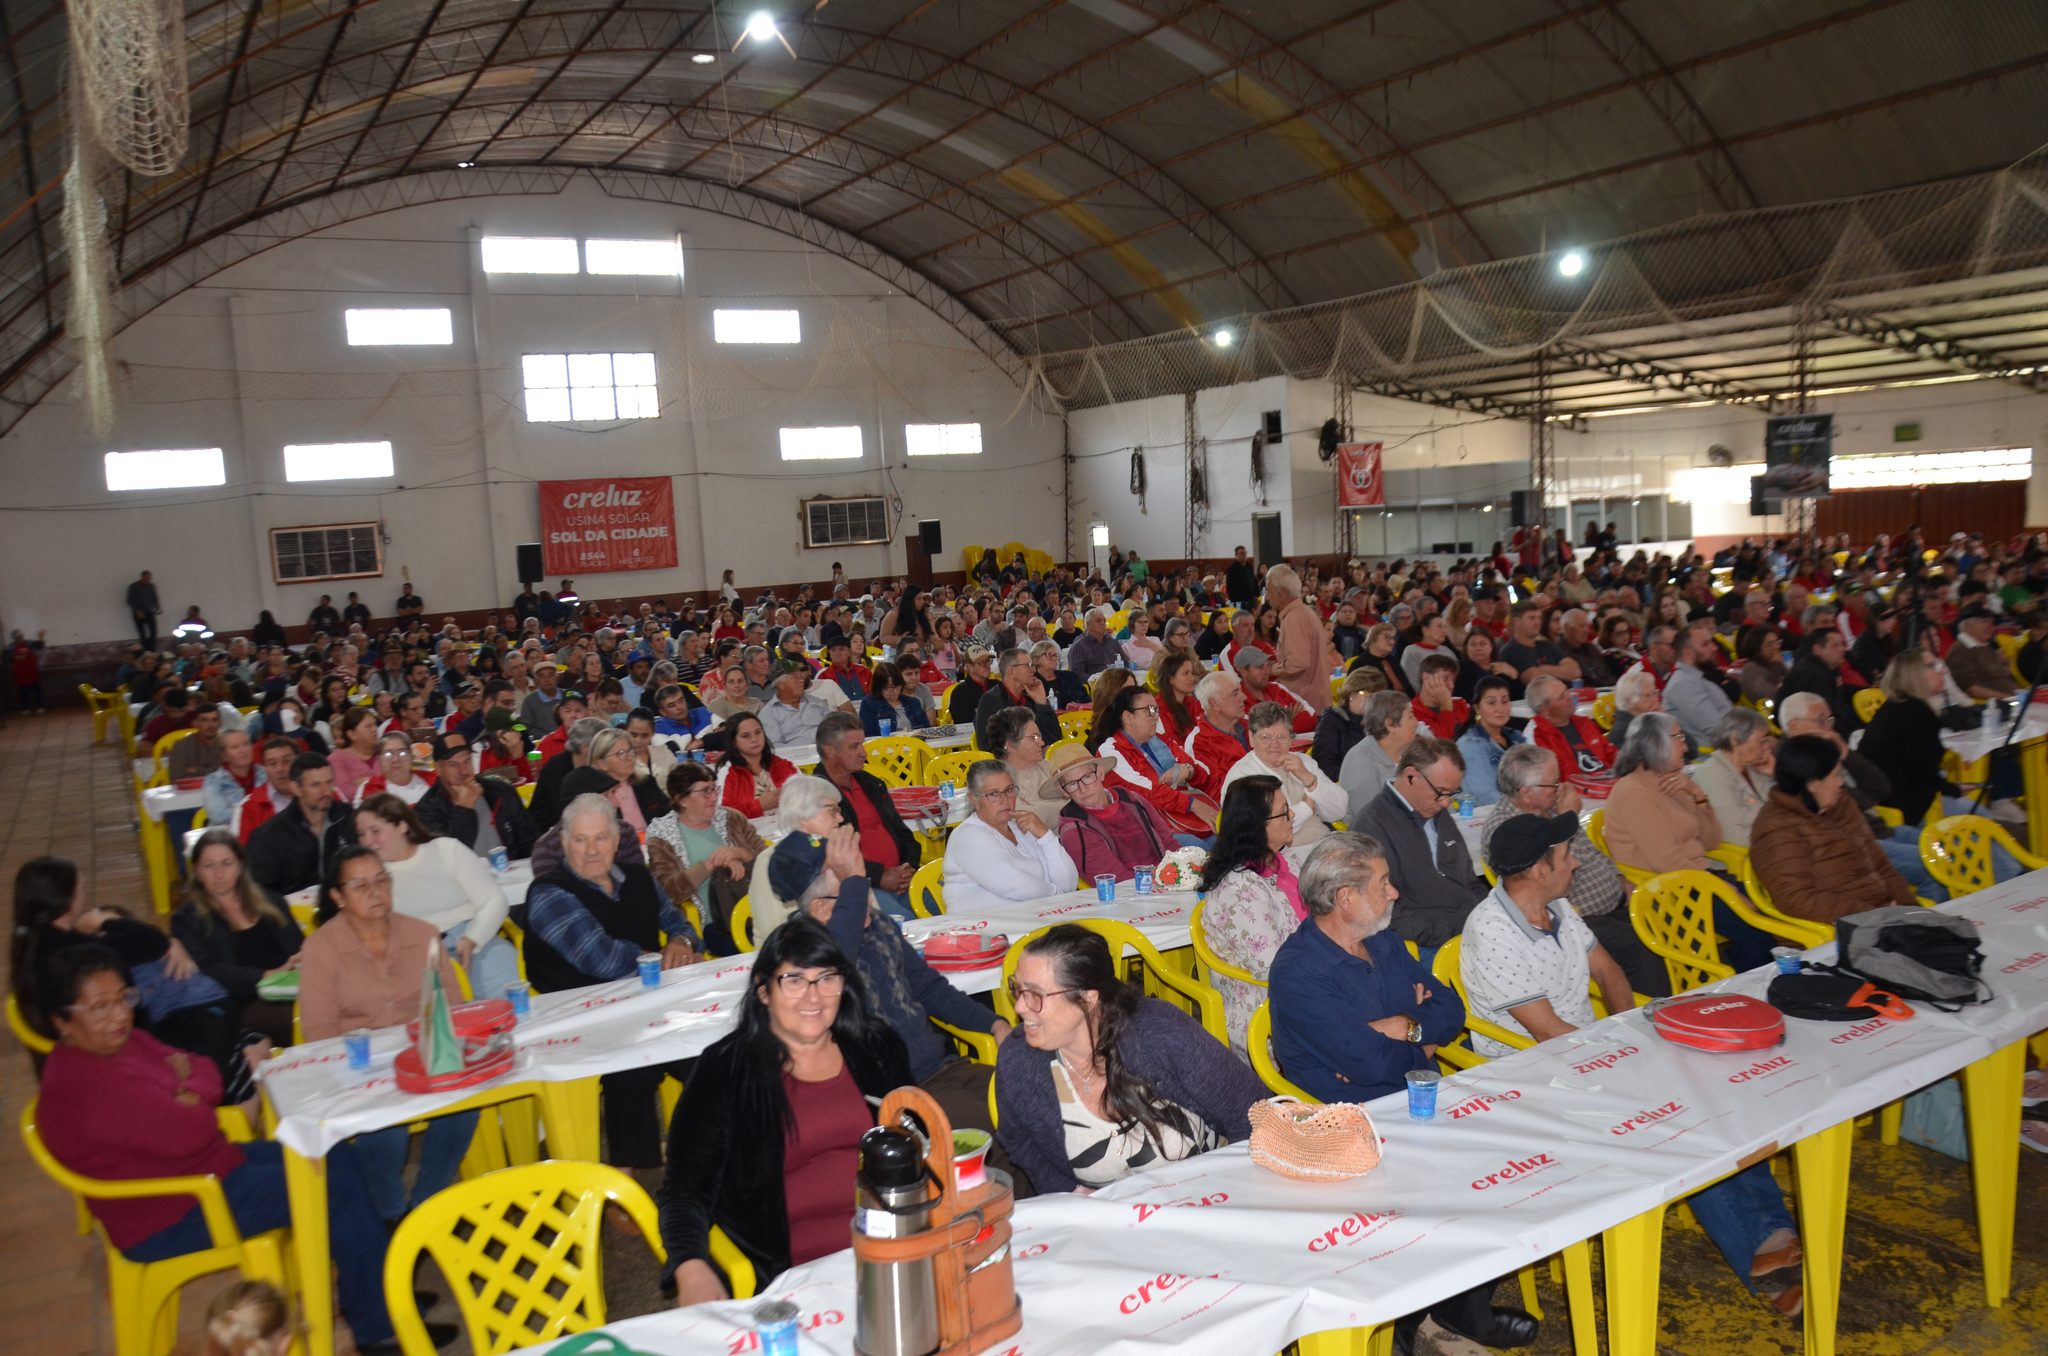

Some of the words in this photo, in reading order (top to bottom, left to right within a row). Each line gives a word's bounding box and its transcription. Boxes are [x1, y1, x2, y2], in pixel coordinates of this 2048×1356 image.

[563, 484, 642, 509] creluz
[566, 514, 606, 527] USINA
[608, 512, 650, 524] SOLAR
[551, 531, 582, 543] SOL
[585, 529, 607, 542] DA
[611, 526, 668, 540] CIDADE
[1699, 1000, 1749, 1015] creluz
[1828, 1018, 1889, 1045] creluz
[1572, 1046, 1639, 1074] creluz
[1728, 1056, 1792, 1083] creluz
[1447, 1089, 1521, 1119] creluz
[1610, 1101, 1683, 1135] creluz
[1471, 1153, 1554, 1190] creluz
